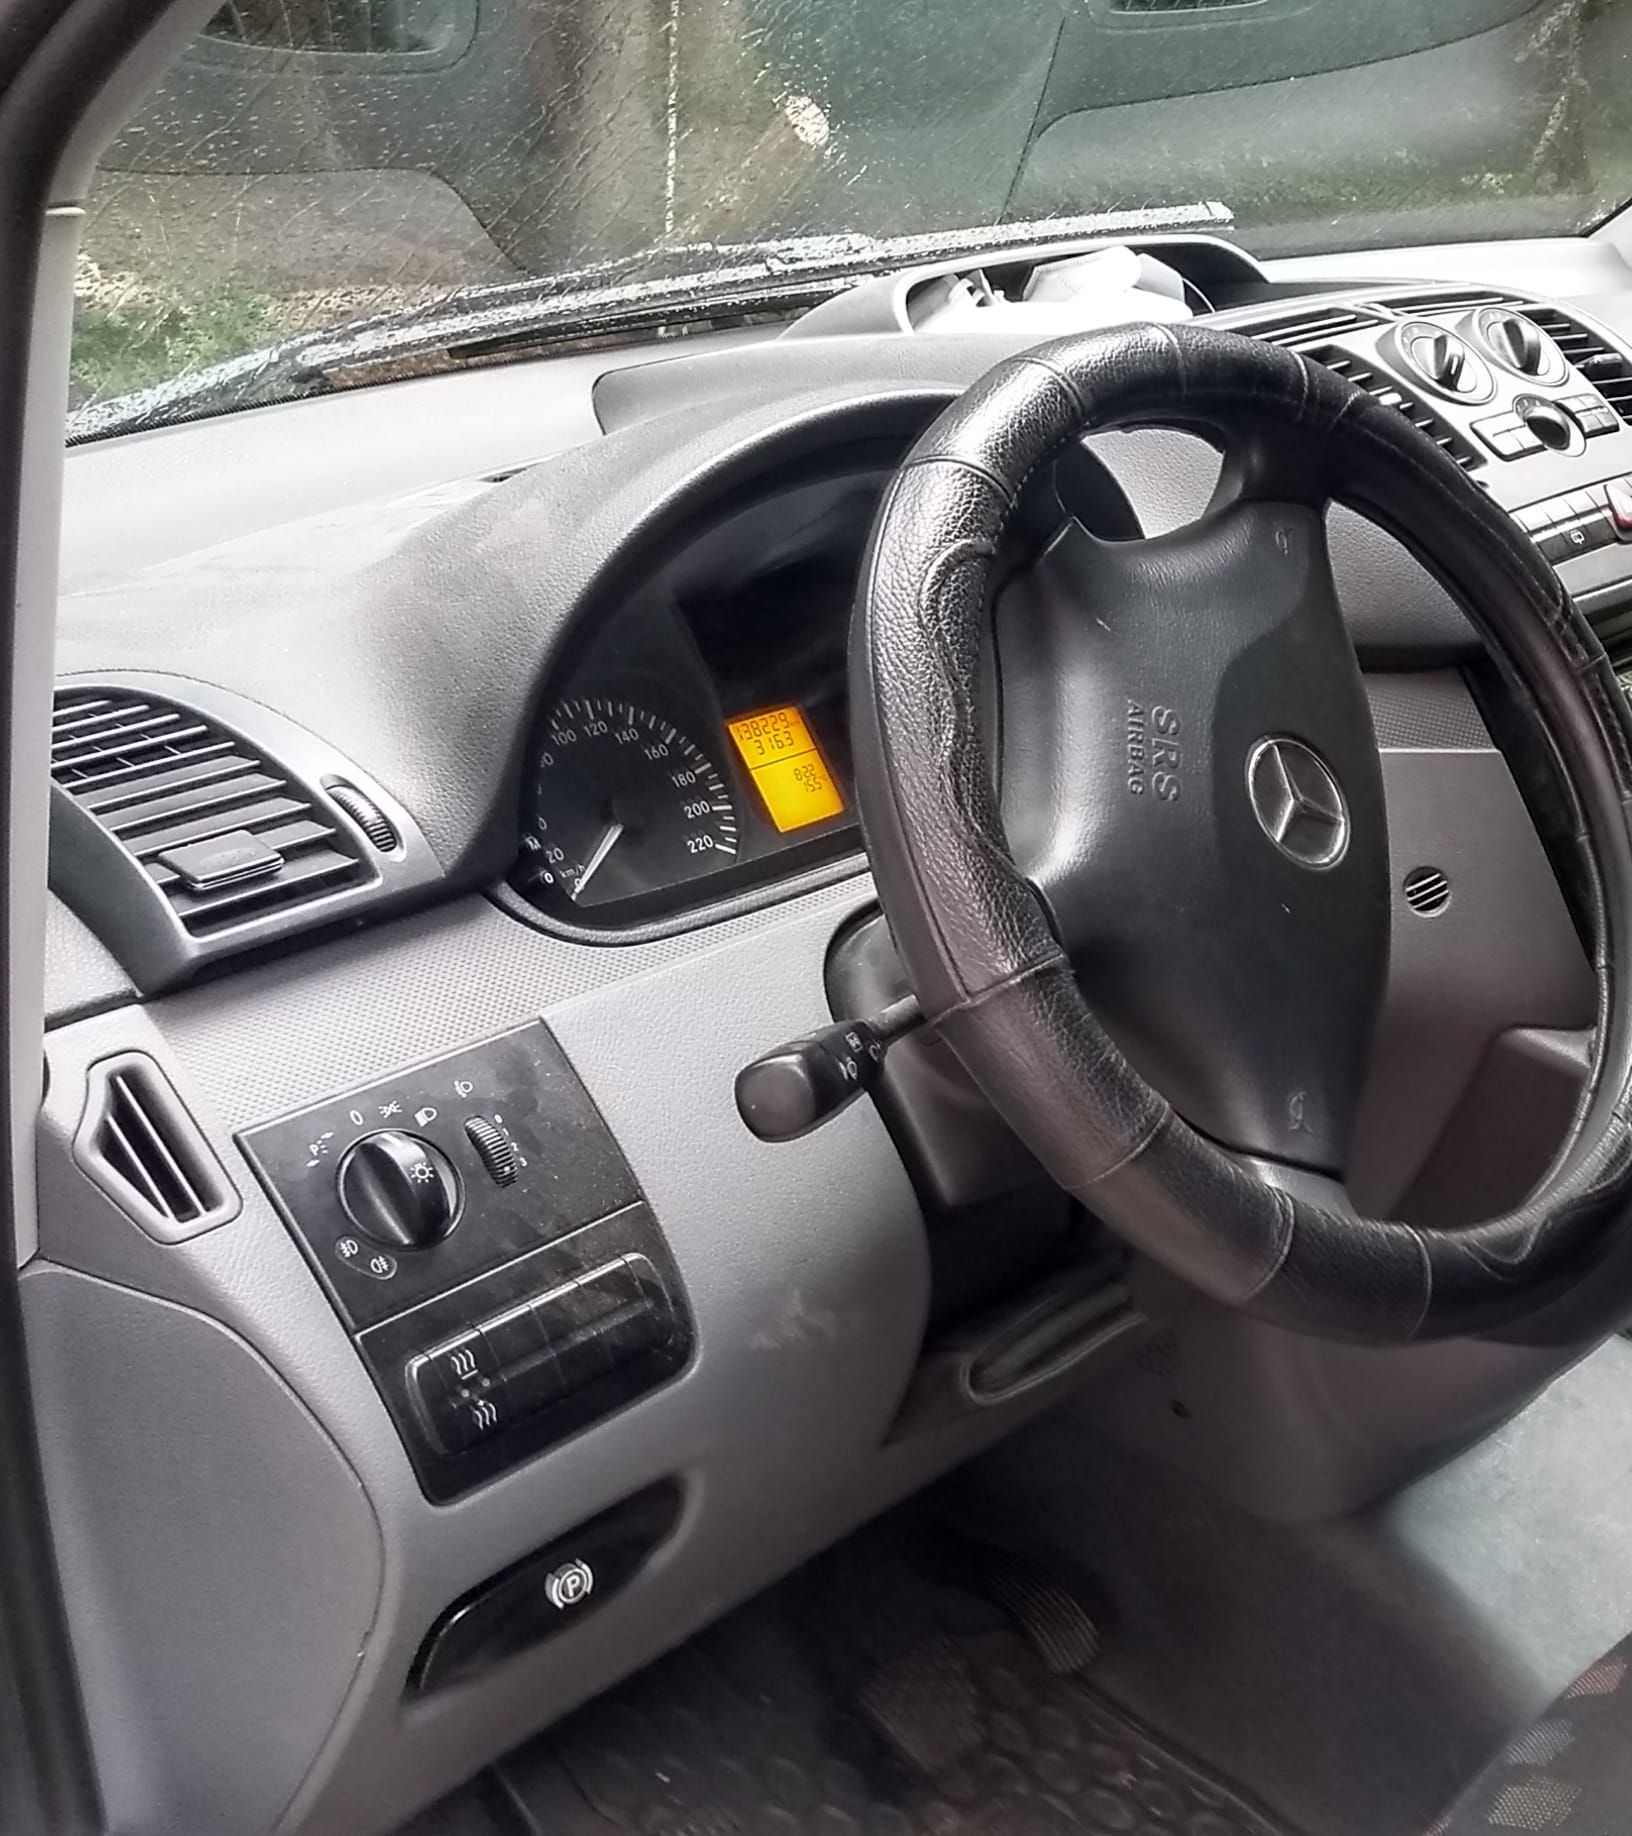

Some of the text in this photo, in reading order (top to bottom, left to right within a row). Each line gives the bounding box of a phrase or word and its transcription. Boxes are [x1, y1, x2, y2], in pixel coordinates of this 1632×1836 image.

[583, 720, 609, 737] 120
[736, 712, 790, 740] 138229
[551, 729, 577, 746] 100
[615, 727, 640, 744] 140
[644, 744, 669, 760] 160
[1127, 699, 1144, 795] AIRBAG
[1151, 706, 1181, 801] SRS
[672, 771, 696, 787] 180
[684, 800, 710, 819] 200
[687, 834, 713, 853] 220
[545, 847, 564, 863] 20
[510, 1142, 520, 1151] 2
[566, 1575, 581, 1597] P
